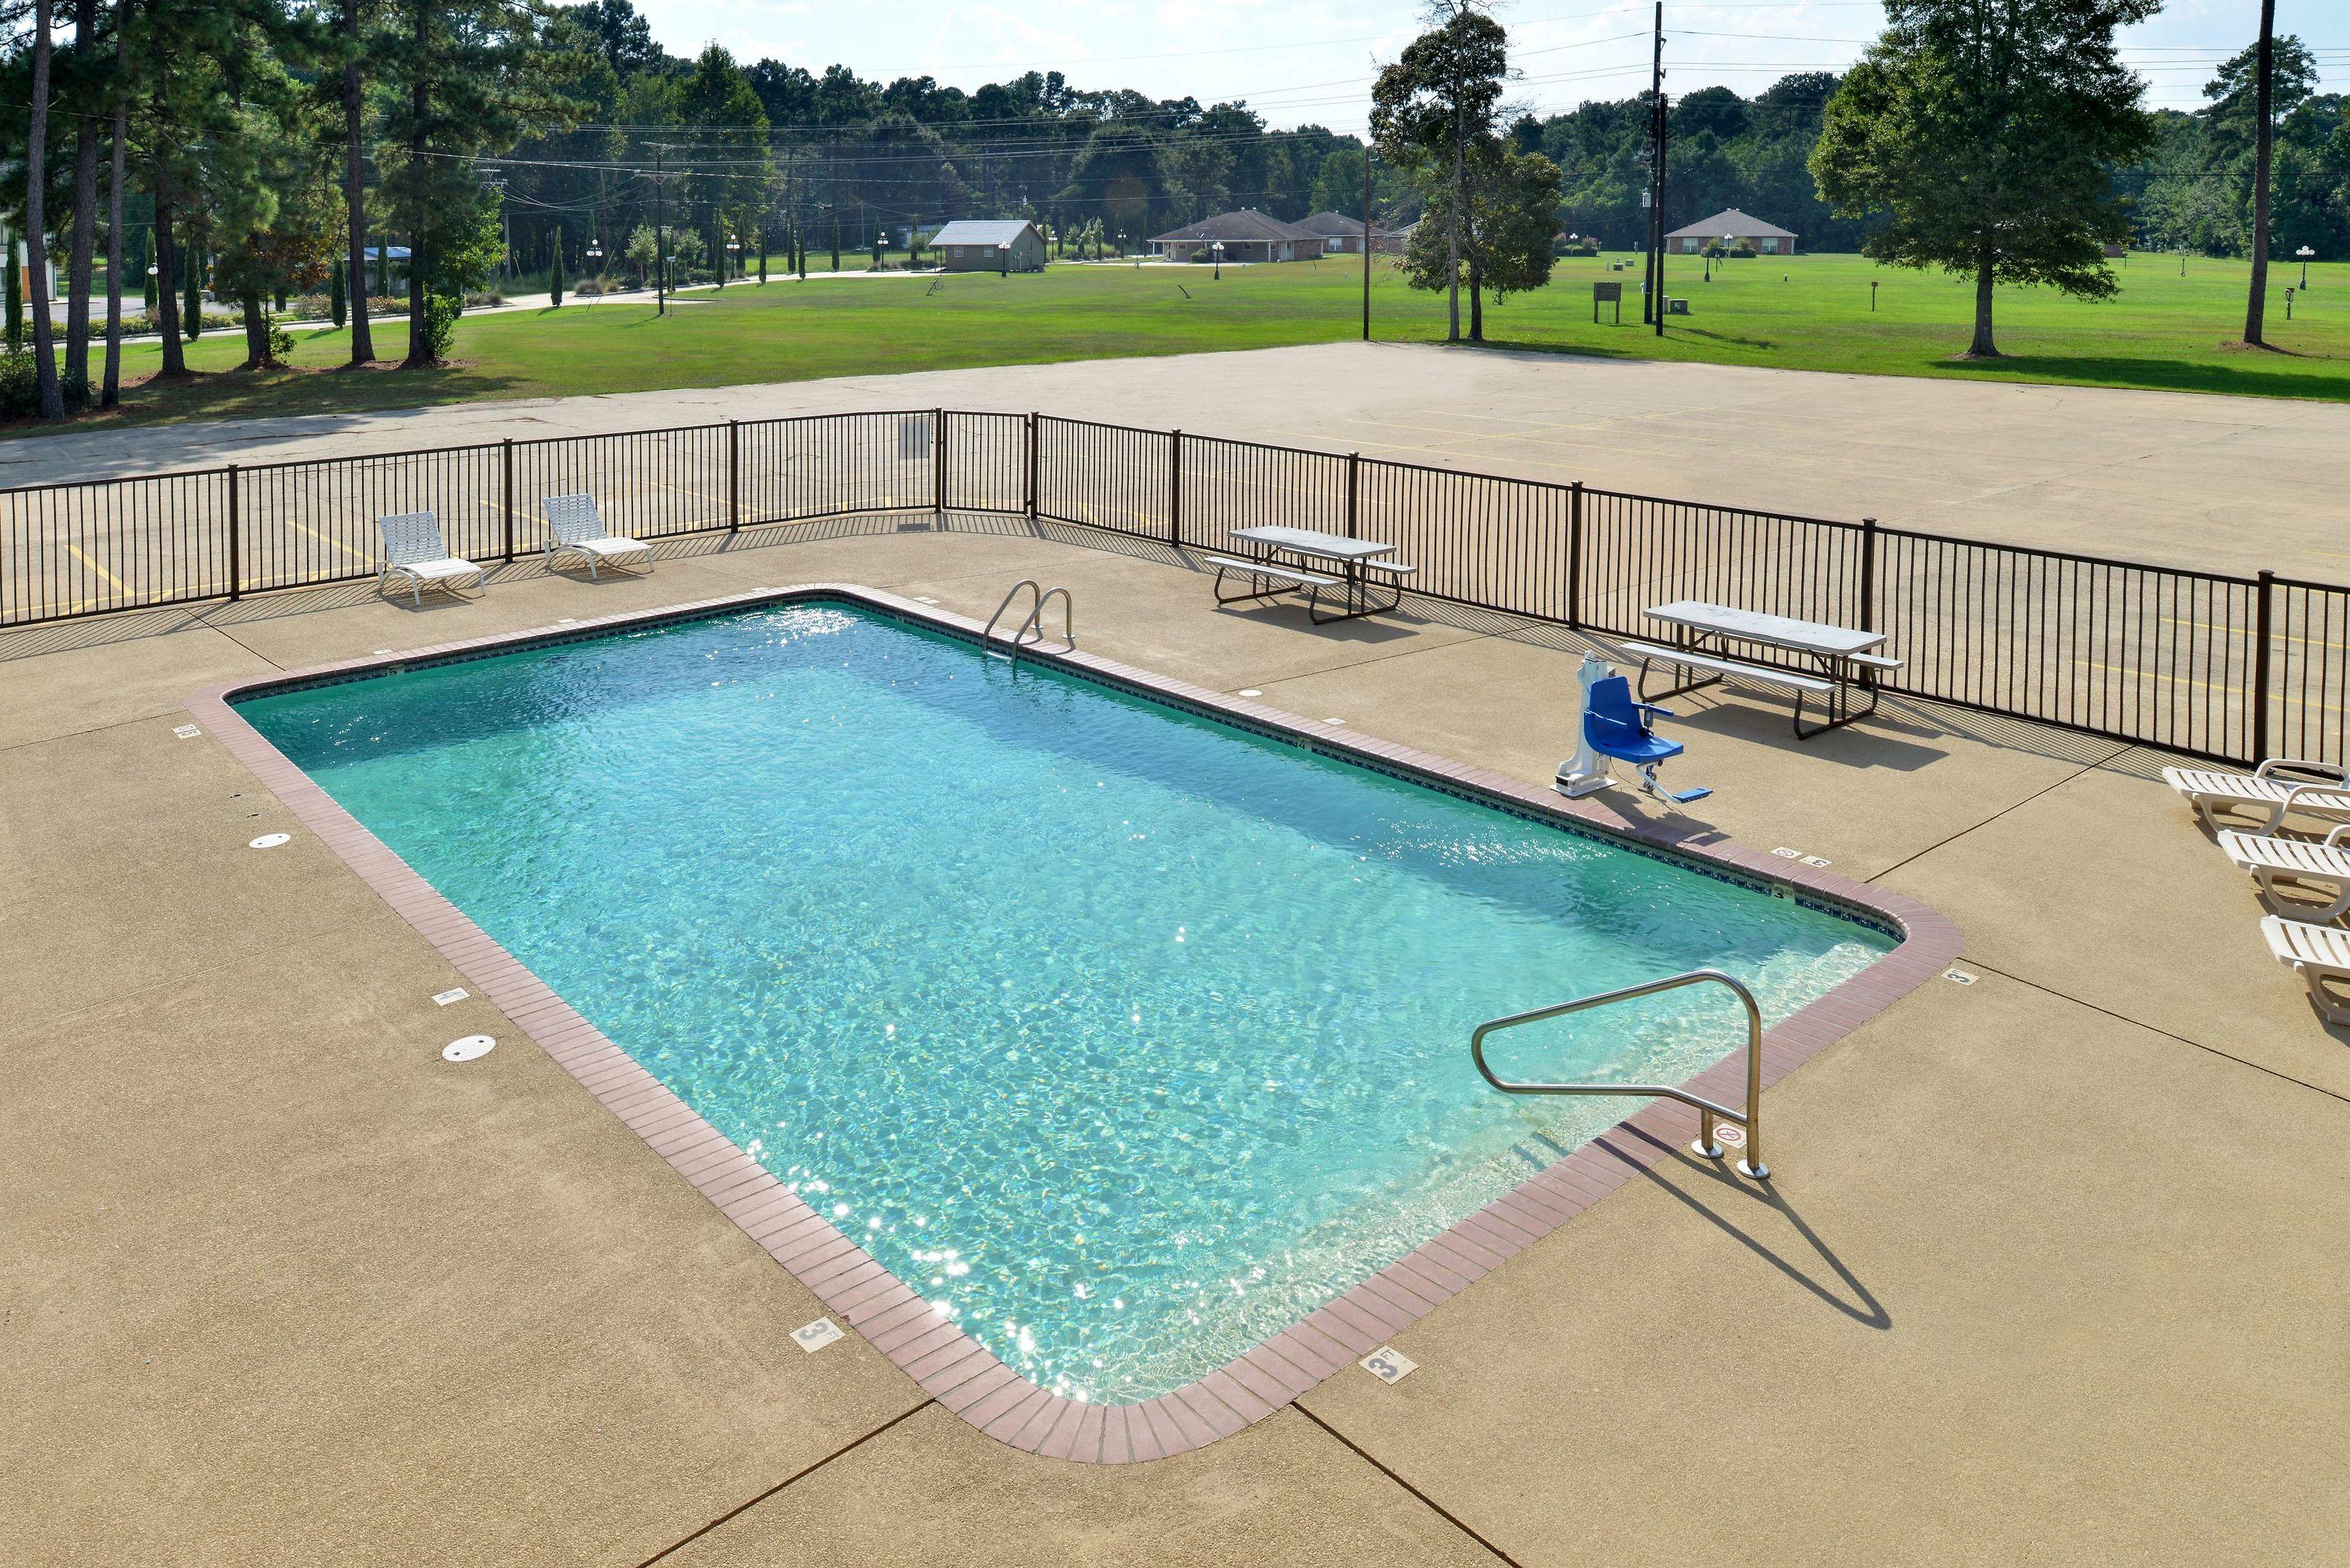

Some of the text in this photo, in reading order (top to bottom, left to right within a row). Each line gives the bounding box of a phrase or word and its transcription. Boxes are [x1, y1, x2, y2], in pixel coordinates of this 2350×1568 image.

[1774, 886, 1784, 899] 3
[1947, 973, 1970, 983] 3
[799, 1322, 839, 1340] 3 FT
[1368, 1349, 1398, 1379] 3 FT
